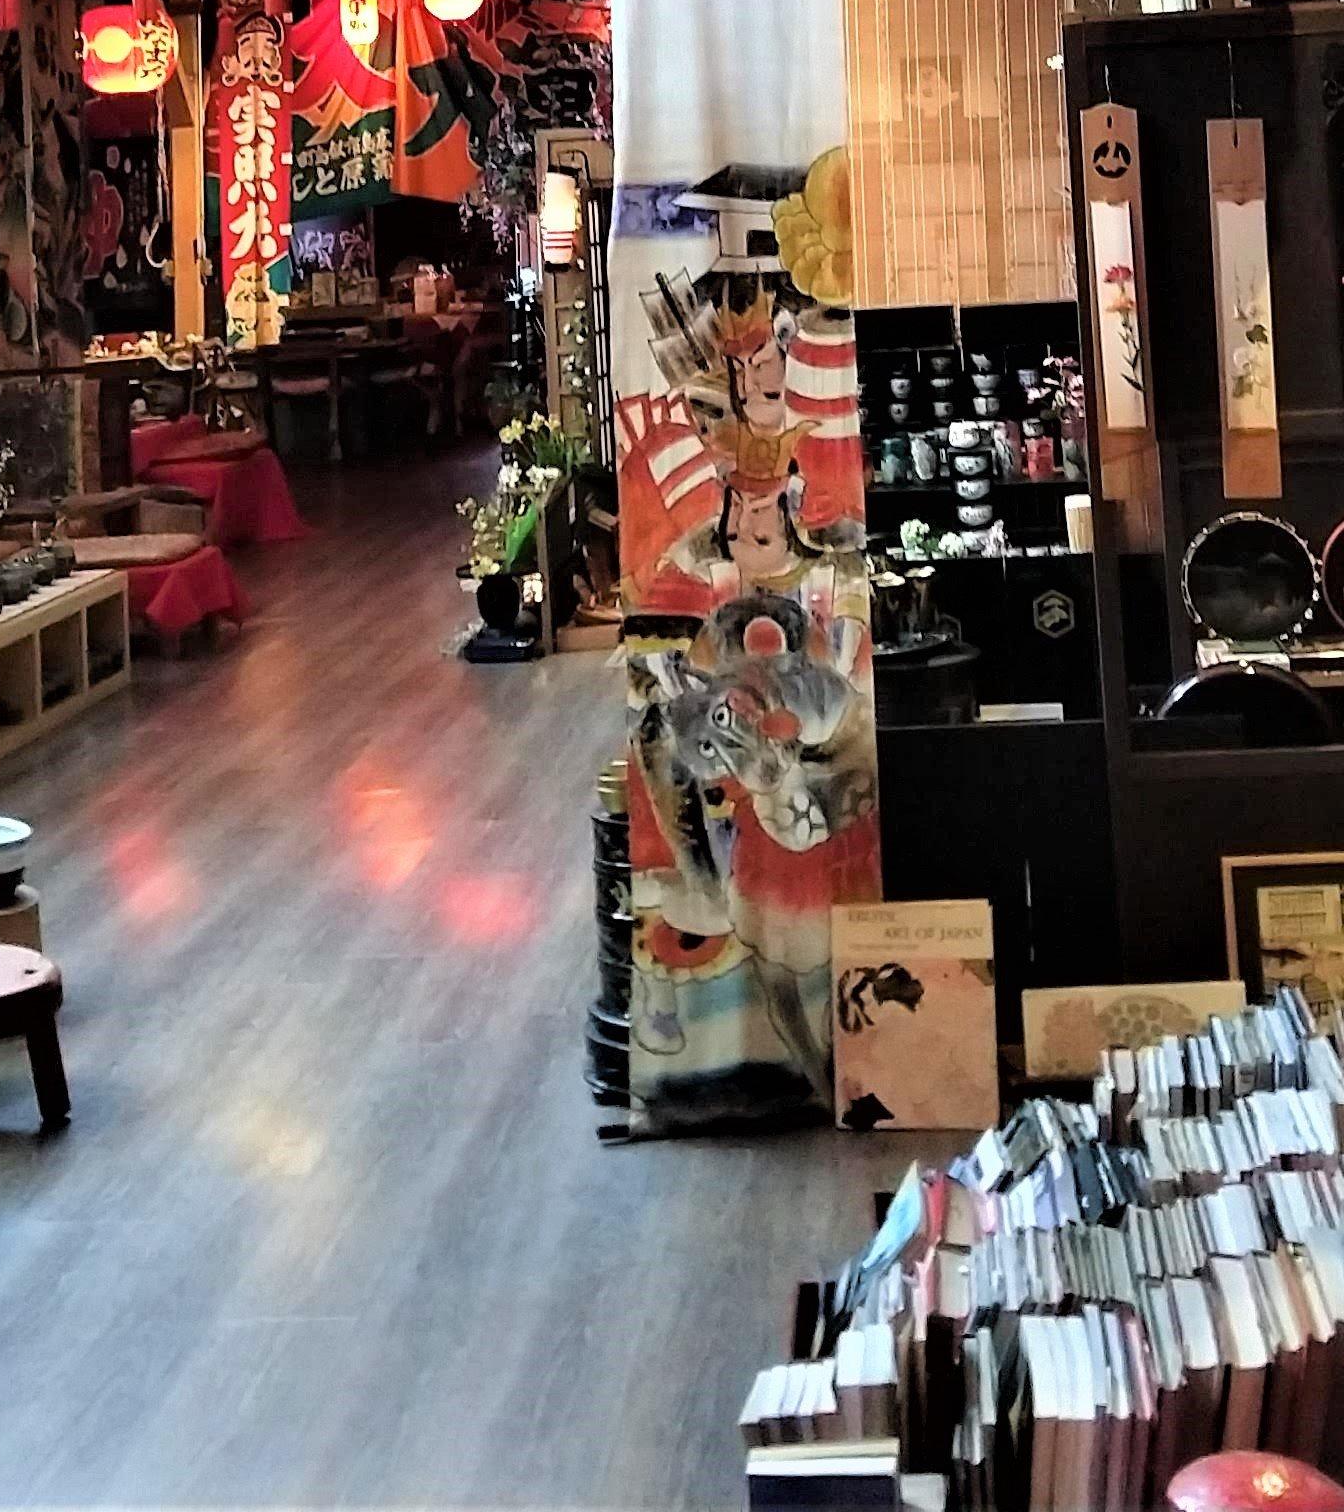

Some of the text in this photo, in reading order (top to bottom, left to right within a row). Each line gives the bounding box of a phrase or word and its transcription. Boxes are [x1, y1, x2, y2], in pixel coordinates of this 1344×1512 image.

[883, 925, 984, 941] ART OF JAPAN
